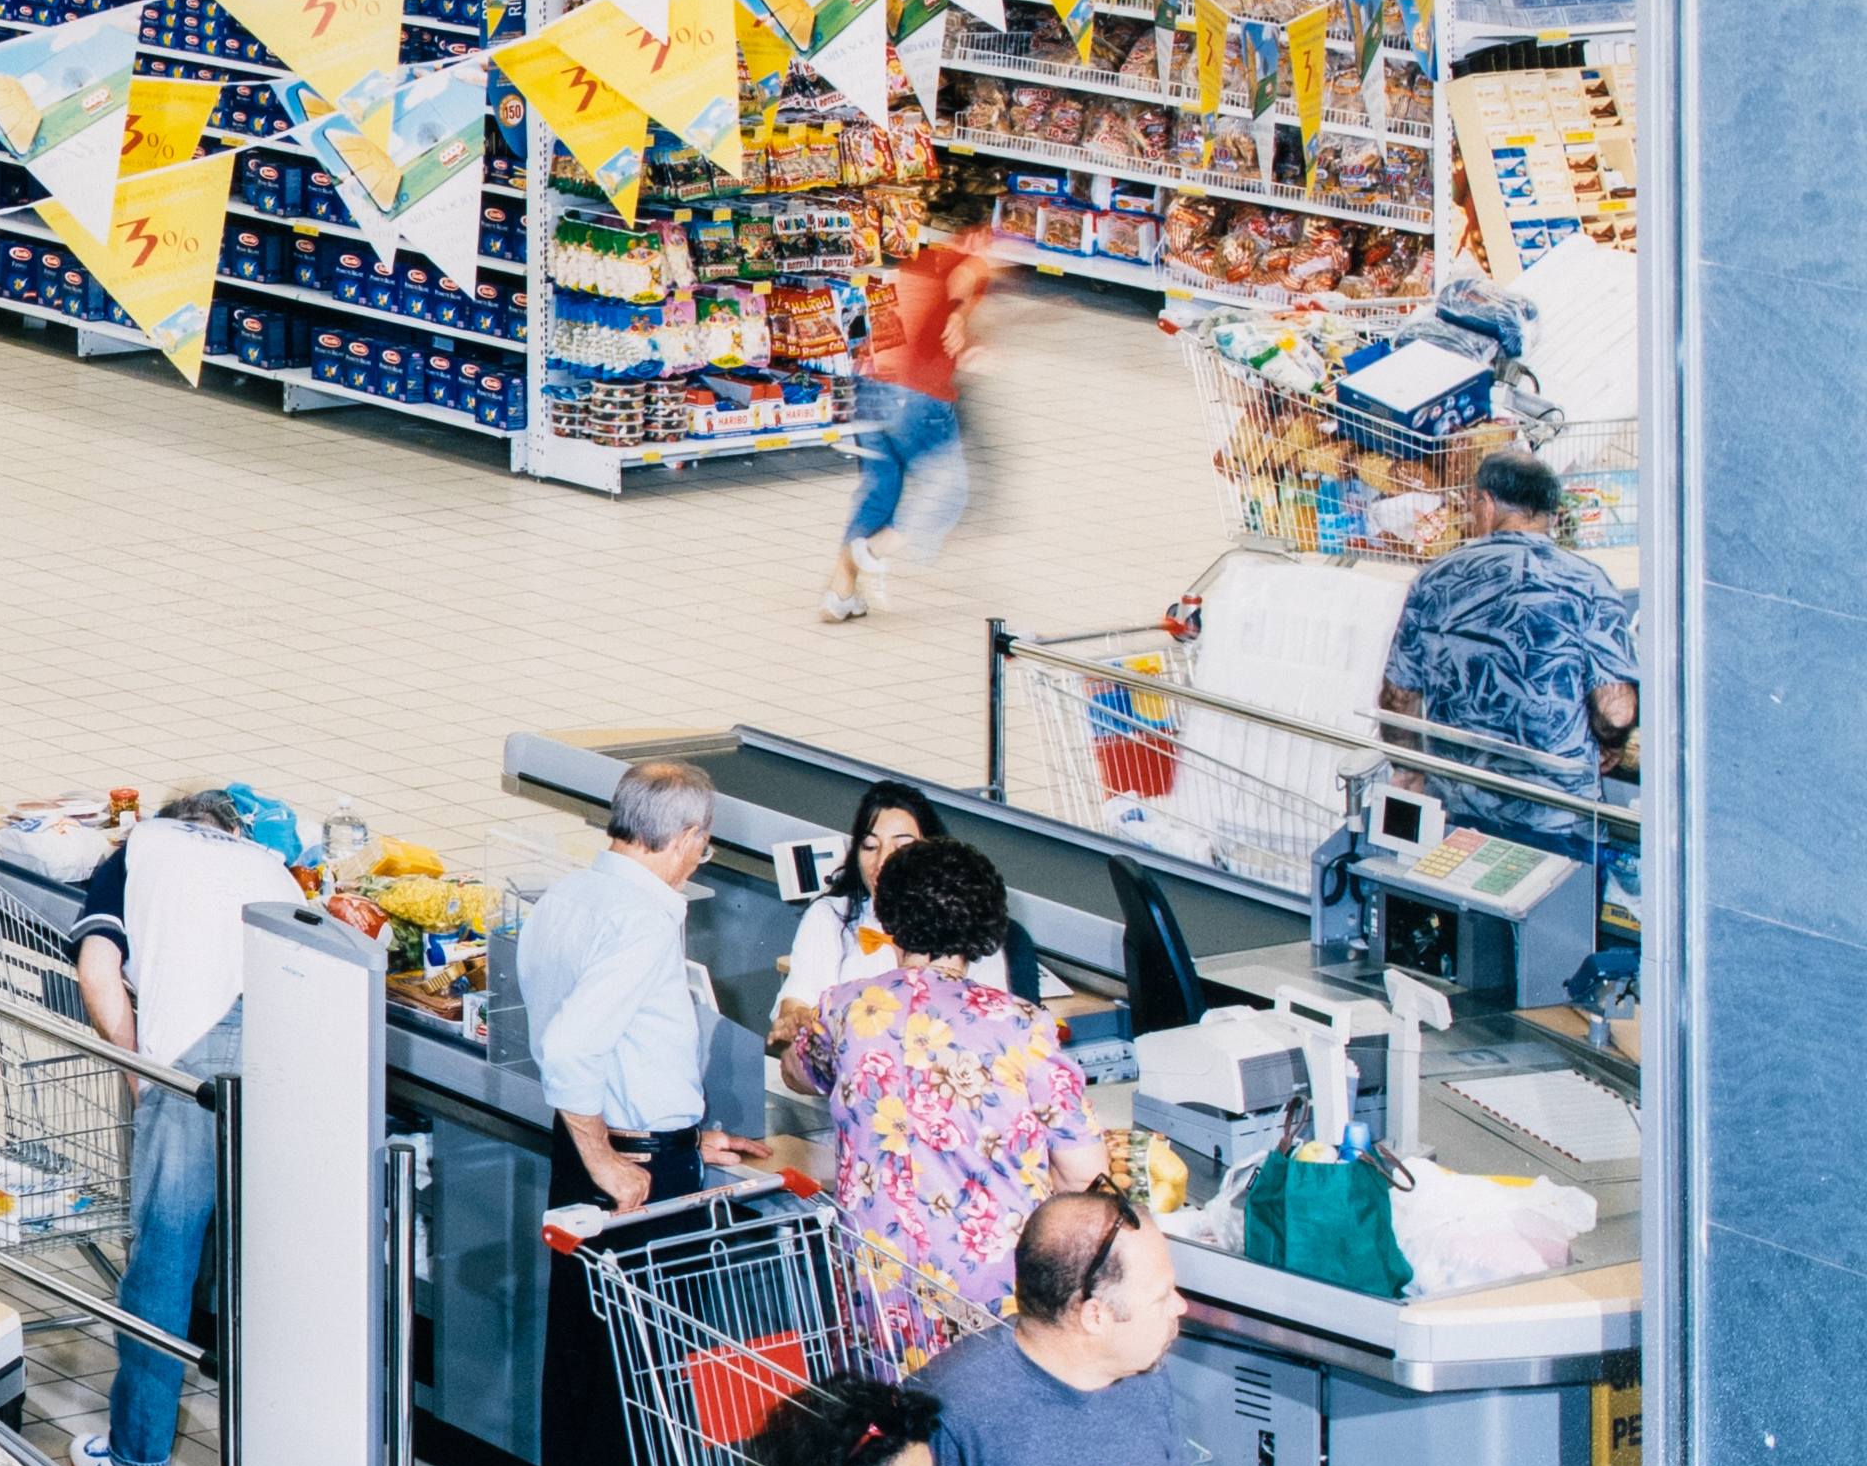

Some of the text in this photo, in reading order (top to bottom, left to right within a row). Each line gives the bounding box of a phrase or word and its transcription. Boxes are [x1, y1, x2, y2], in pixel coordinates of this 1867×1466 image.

[792, 296, 831, 315] HARIBO
[785, 407, 815, 420] HARIBO
[718, 414, 748, 427] HARIBO
